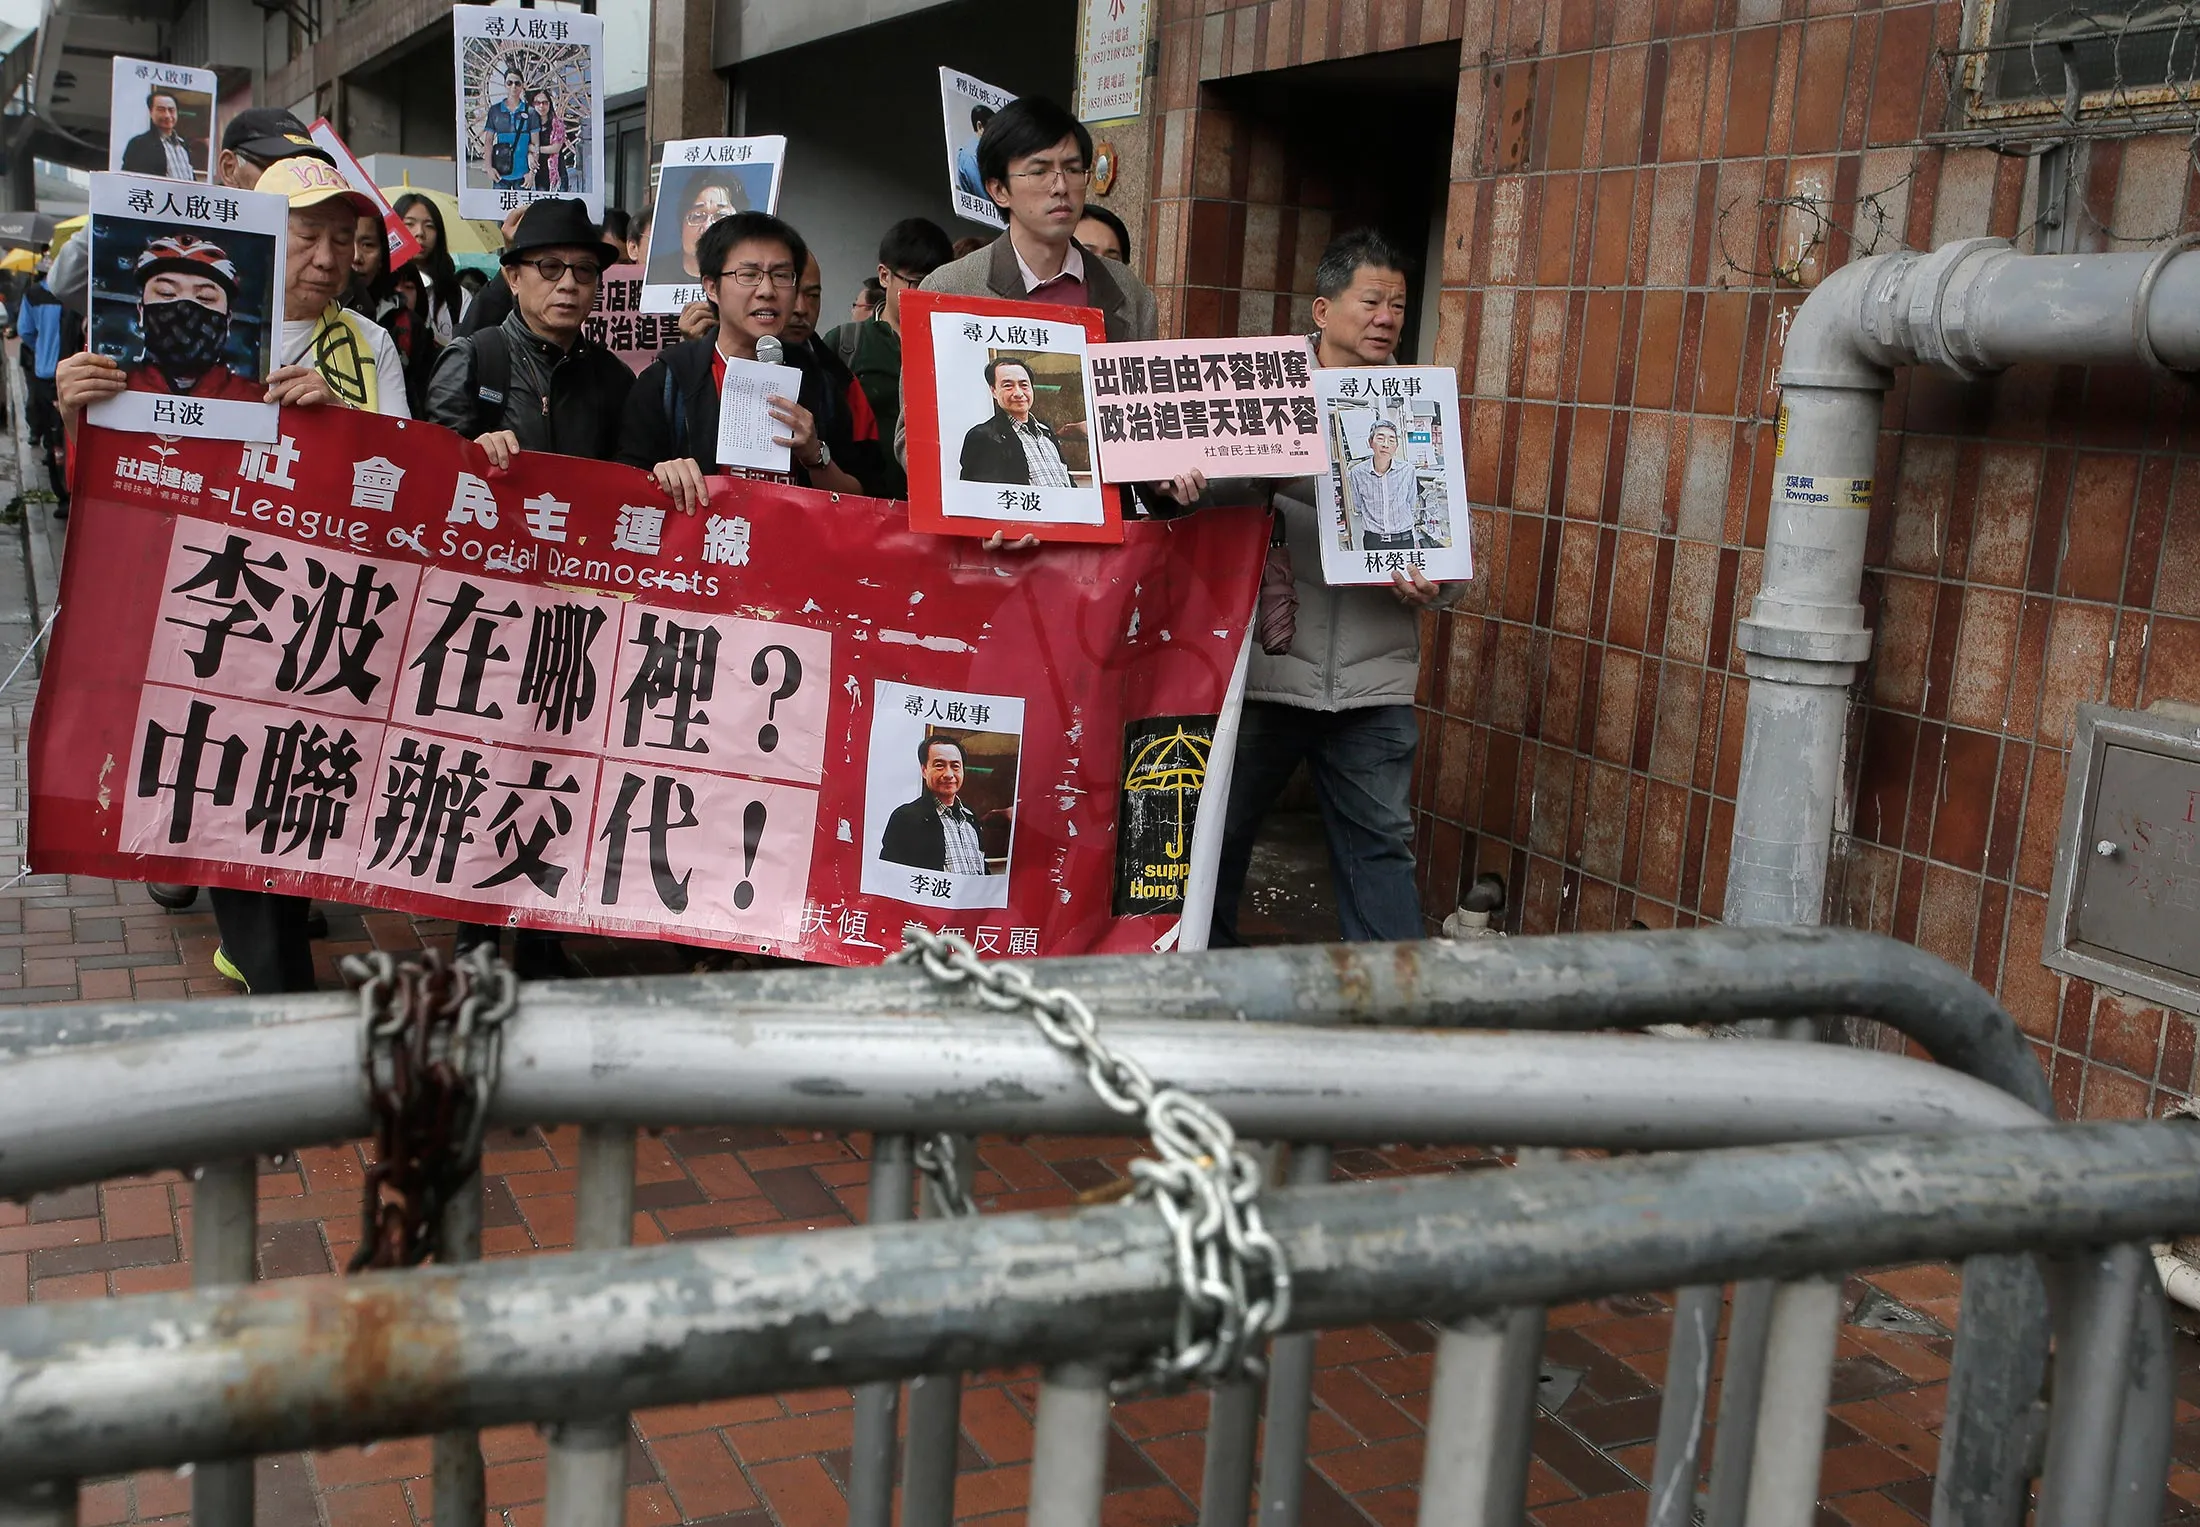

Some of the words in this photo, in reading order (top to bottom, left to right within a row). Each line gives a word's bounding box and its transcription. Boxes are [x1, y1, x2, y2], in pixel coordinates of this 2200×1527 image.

[485, 16, 569, 40] 尋人啟事
[135, 65, 193, 86] 尋人啟事
[684, 145, 753, 163] 尋人啟事
[128, 188, 240, 223] 尋人啟事
[960, 193, 1006, 222] 還我出
[963, 321, 1051, 347] 尋人啟事
[1091, 350, 1311, 397] 出版自由不容剝奪
[1339, 377, 1422, 397] 尋人啟事
[153, 399, 205, 426] 呂波
[1098, 395, 1320, 443] 政治迫害天理不容
[115, 456, 204, 494] 社民連線
[997, 489, 1042, 512] 李波
[1785, 488, 1829, 503] Towngas
[231, 486, 370, 543] League
[386, 523, 426, 549] of
[439, 529, 539, 571] Social
[548, 548, 719, 597] Democrats
[1364, 551, 1426, 573] 林榮基
[903, 693, 991, 726] 尋人啟事
[909, 873, 952, 900] 李波
[1130, 880, 1177, 900] Hong
